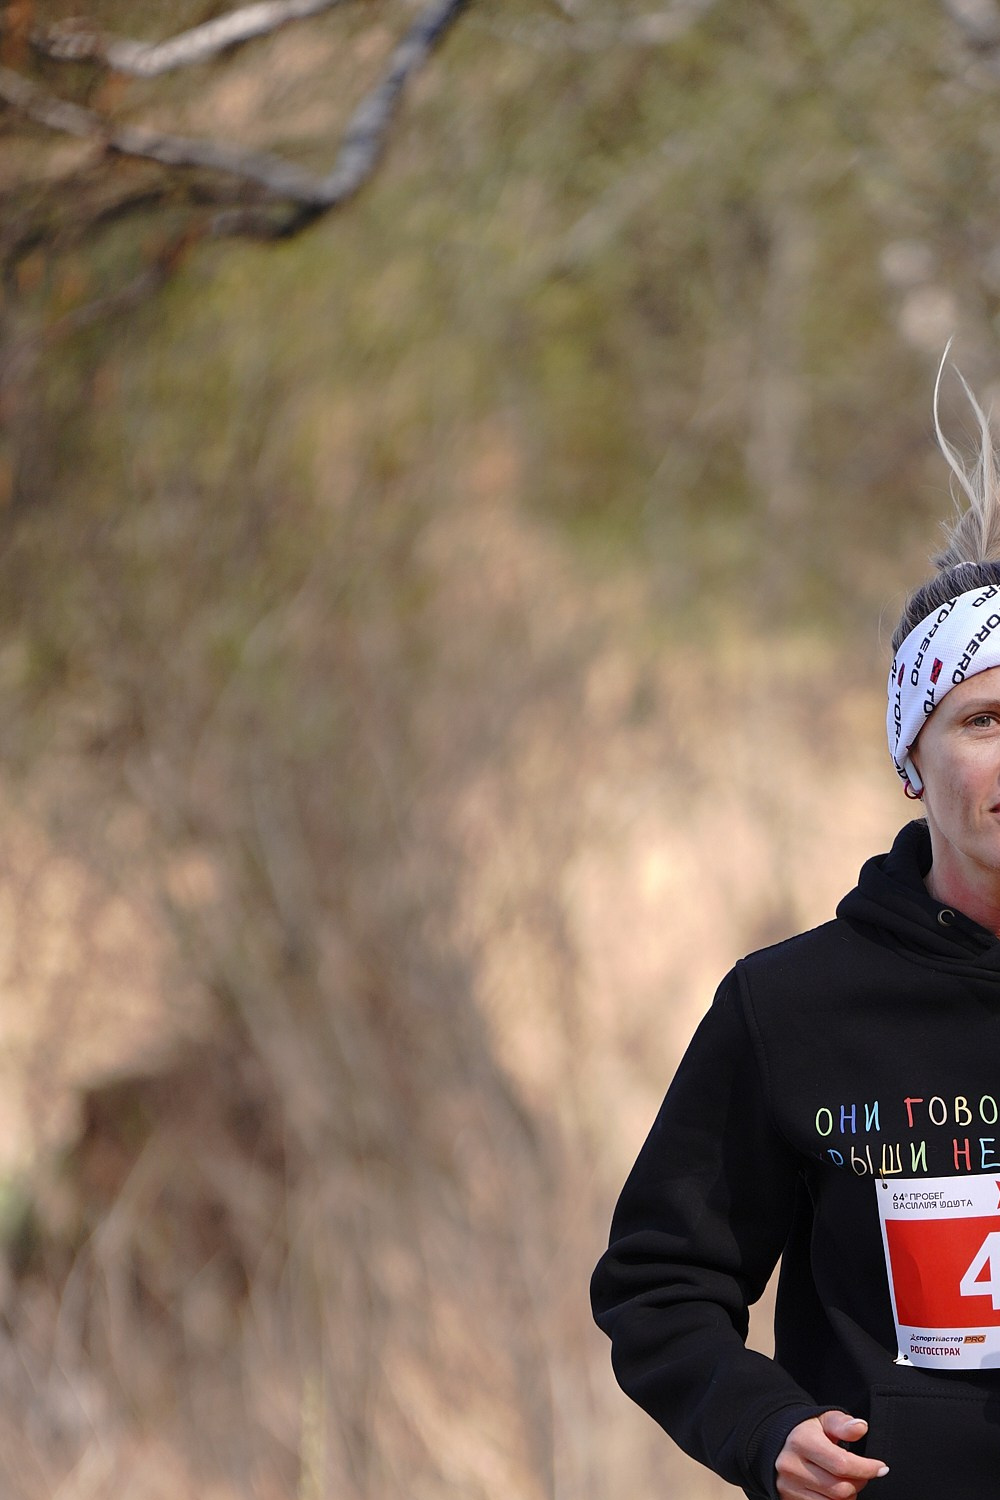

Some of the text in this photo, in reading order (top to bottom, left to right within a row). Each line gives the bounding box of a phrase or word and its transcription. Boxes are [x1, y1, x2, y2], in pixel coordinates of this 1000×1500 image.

[910, 599, 958, 687] TORERO
[815, 1100, 881, 1137] ОНИ
[818, 1140, 928, 1176] РЫШИ
[952, 1137, 1000, 1171] НЕ
[909, 1191, 945, 1201] ПРОБЕГ
[893, 1201, 938, 1210] ВАСИЛИЯ
[964, 1335, 986, 1343] PRO
[910, 1345, 961, 1356] РОСГОССТРАХ
